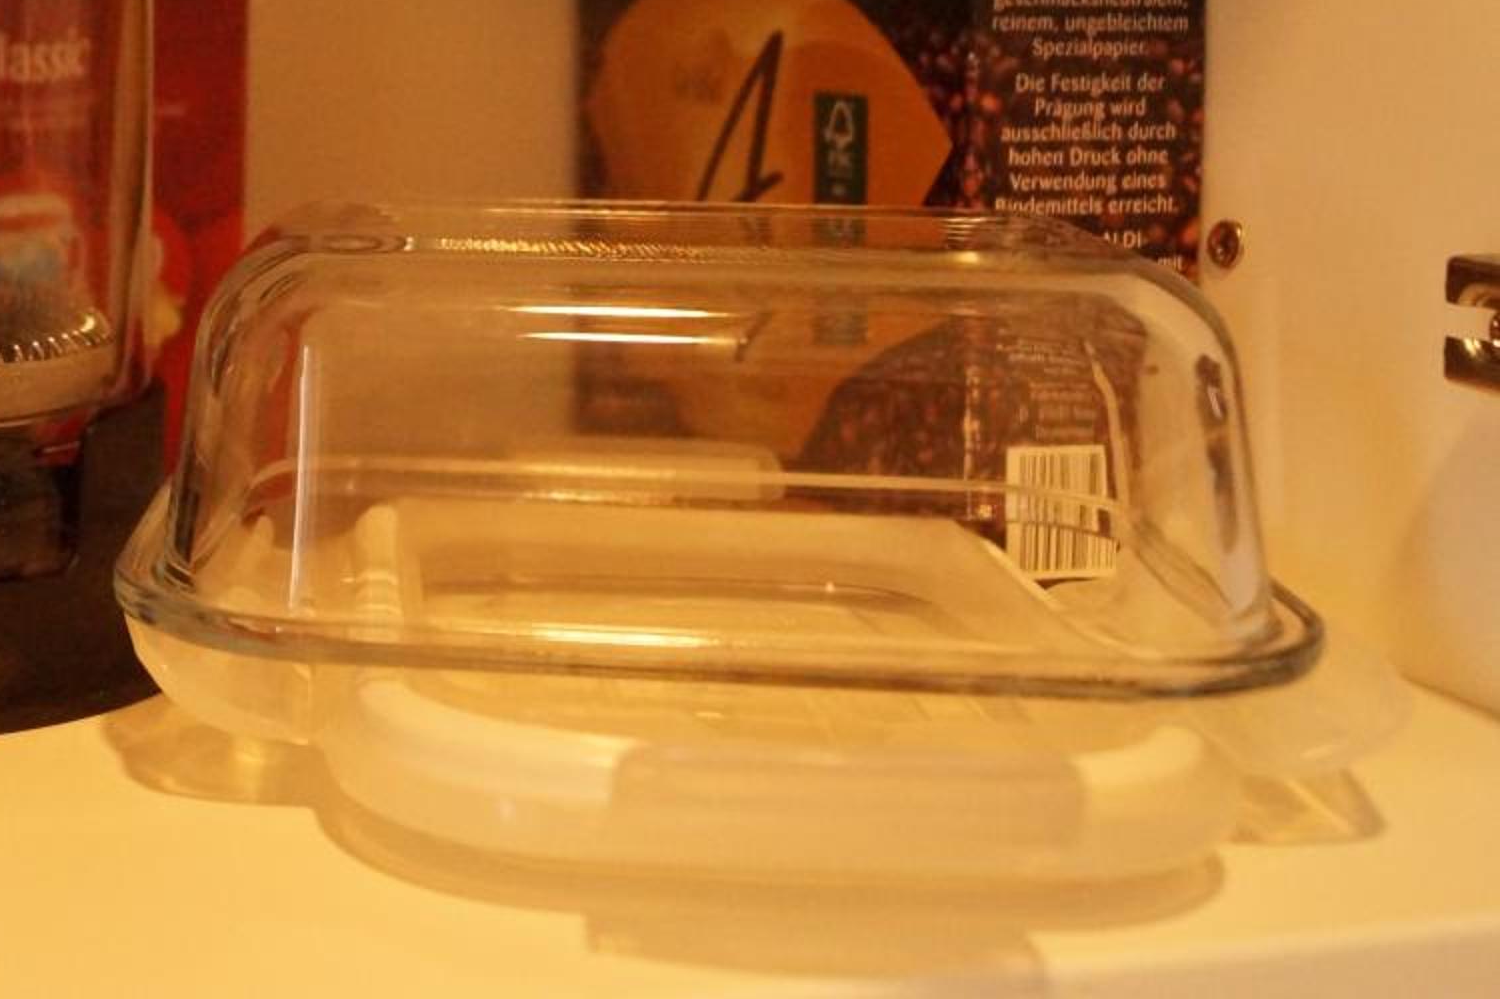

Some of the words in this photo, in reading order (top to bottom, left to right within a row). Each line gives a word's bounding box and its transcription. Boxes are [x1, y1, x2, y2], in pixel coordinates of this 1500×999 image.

[1065, 13, 1189, 38] ungebleichtem
[1032, 37, 1149, 61] Spezialpapier.
[1016, 73, 1045, 92] Die
[1051, 72, 1131, 97] Festigkeit
[1137, 73, 1164, 91] der
[1109, 97, 1147, 116] wird
[1000, 122, 1122, 142] ausschließlich
[1128, 122, 1176, 141] durch
[1009, 148, 1063, 166] hohen
[1070, 147, 1121, 166] Druck
[1126, 147, 1168, 164] ohne
[1010, 172, 1118, 195] Verwendung
[1122, 172, 1166, 189] eines
[1108, 195, 1180, 214] erreicht.
